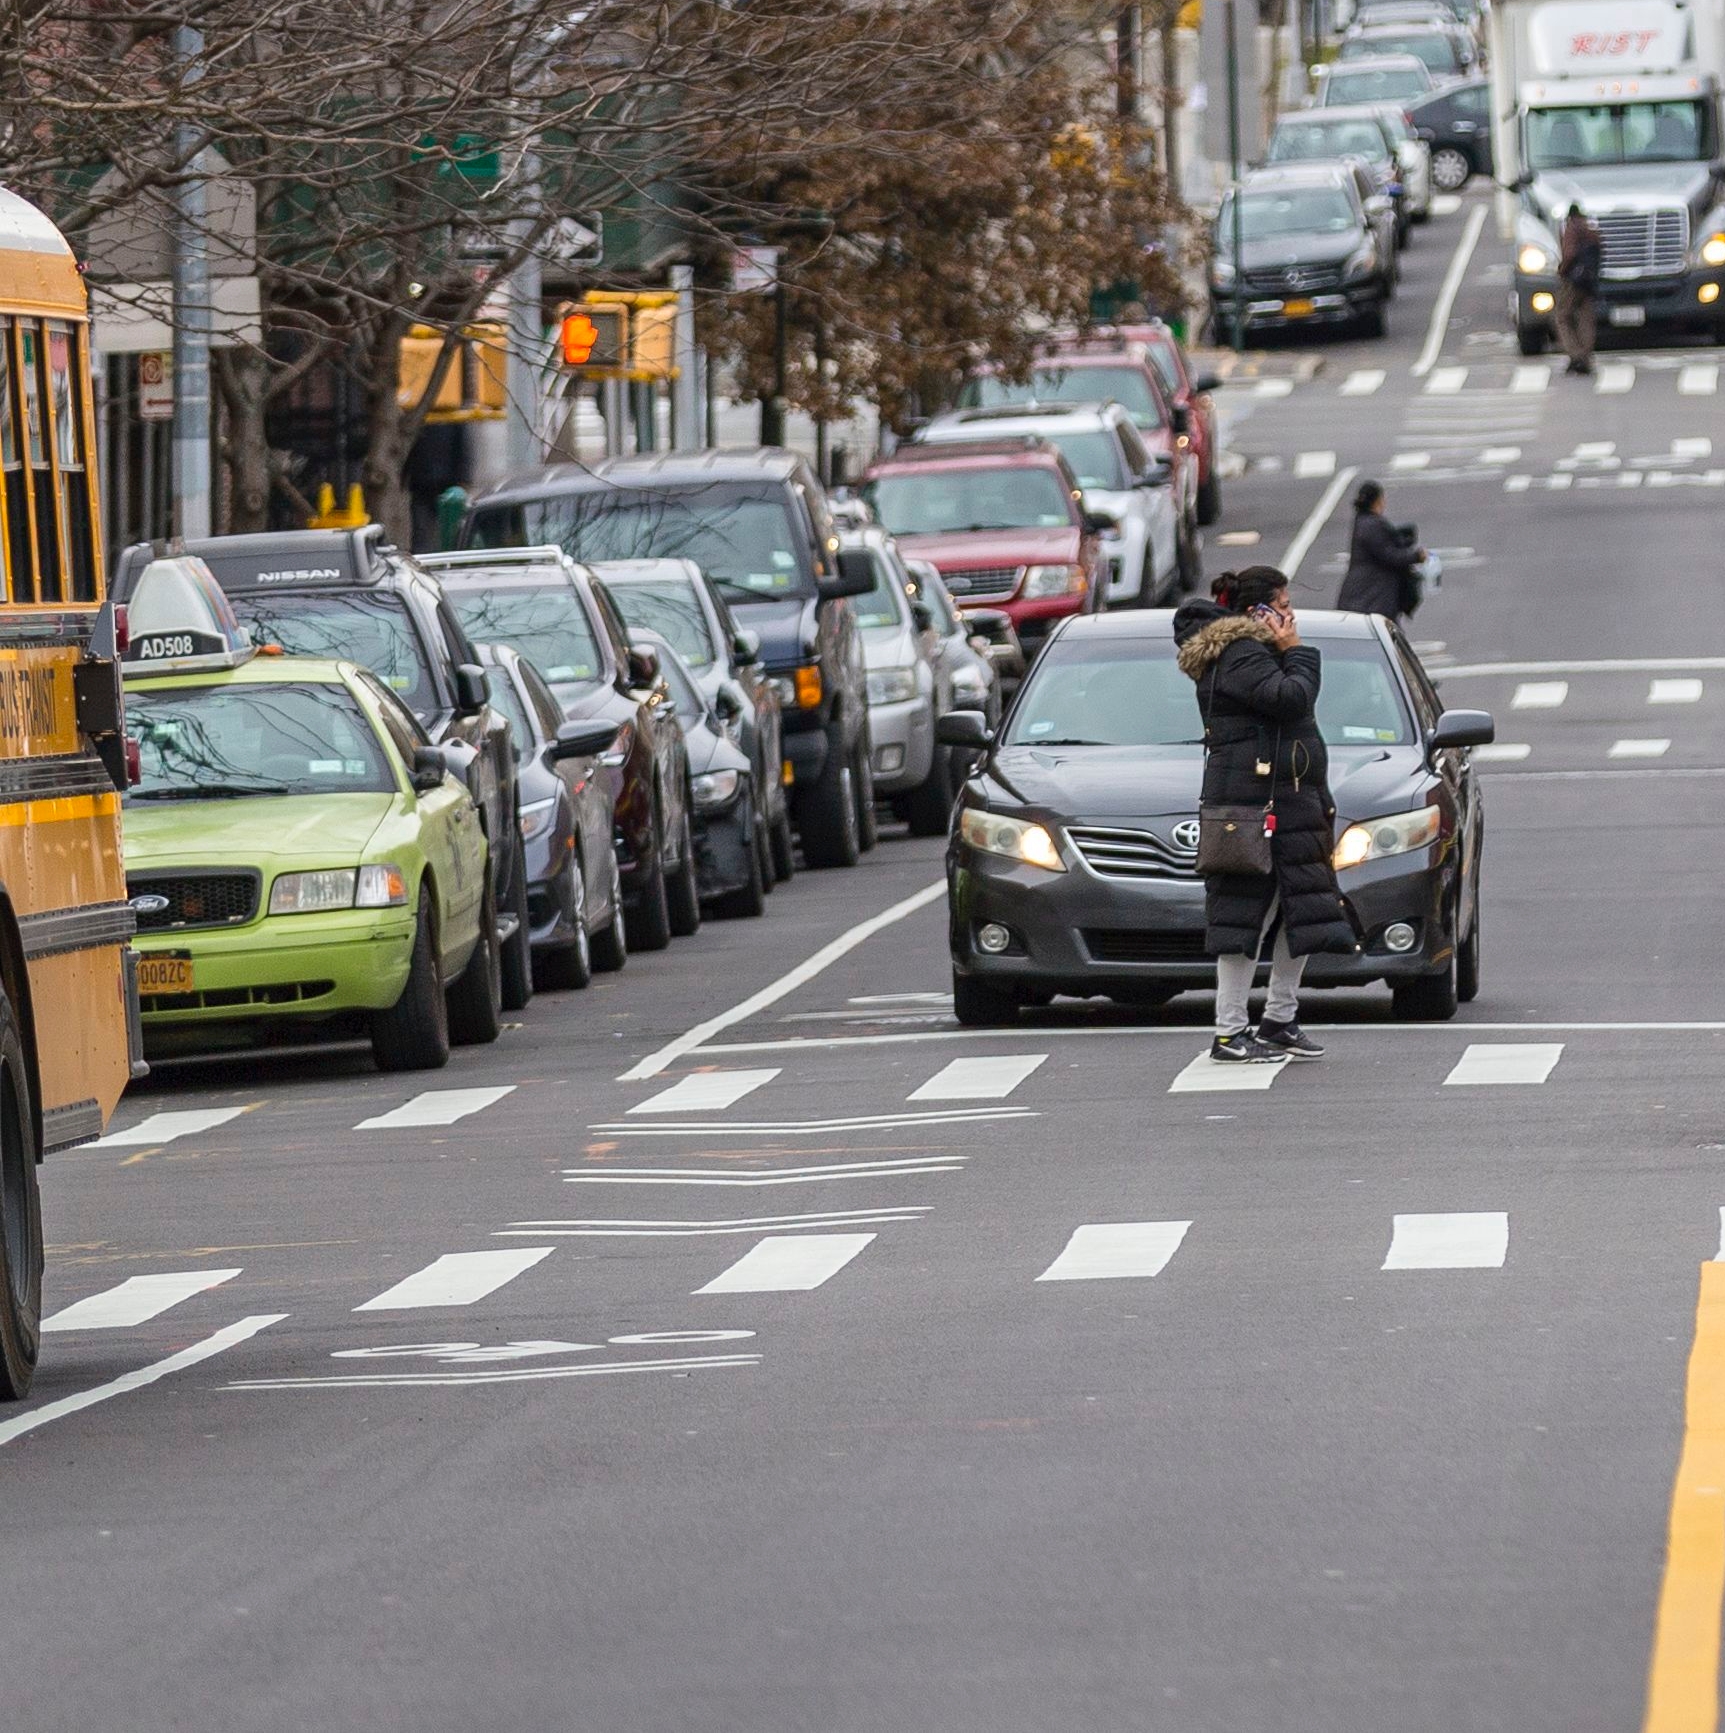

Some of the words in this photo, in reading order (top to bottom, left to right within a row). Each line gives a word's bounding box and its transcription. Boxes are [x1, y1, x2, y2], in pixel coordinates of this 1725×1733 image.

[1570, 29, 1660, 55] RIST
[258, 569, 340, 582] NISSAN
[140, 635, 194, 659] AD508
